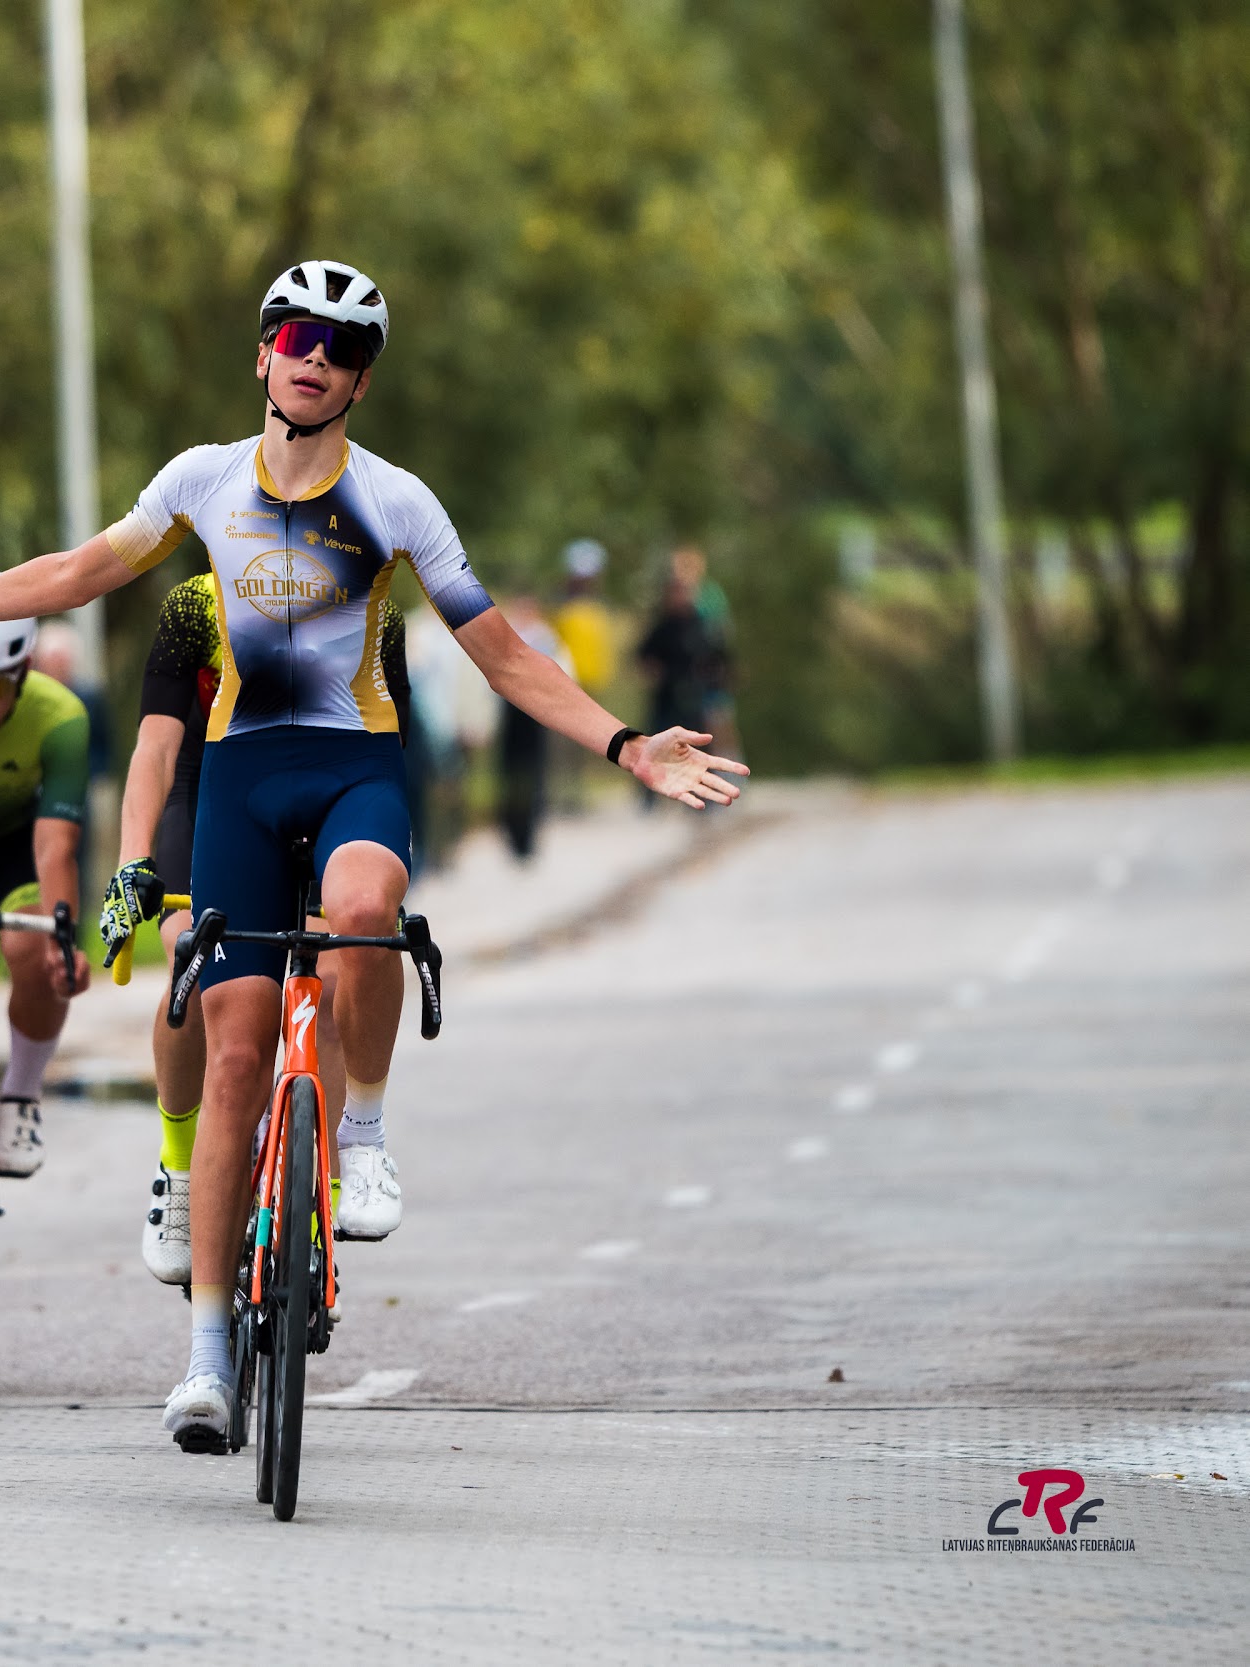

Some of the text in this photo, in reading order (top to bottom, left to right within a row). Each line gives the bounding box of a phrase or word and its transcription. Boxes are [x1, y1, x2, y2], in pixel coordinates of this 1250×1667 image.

[329, 514, 338, 531] A
[233, 578, 348, 605] GOLDINGEN
[214, 942, 227, 963] A
[177, 952, 205, 1003] SRAM
